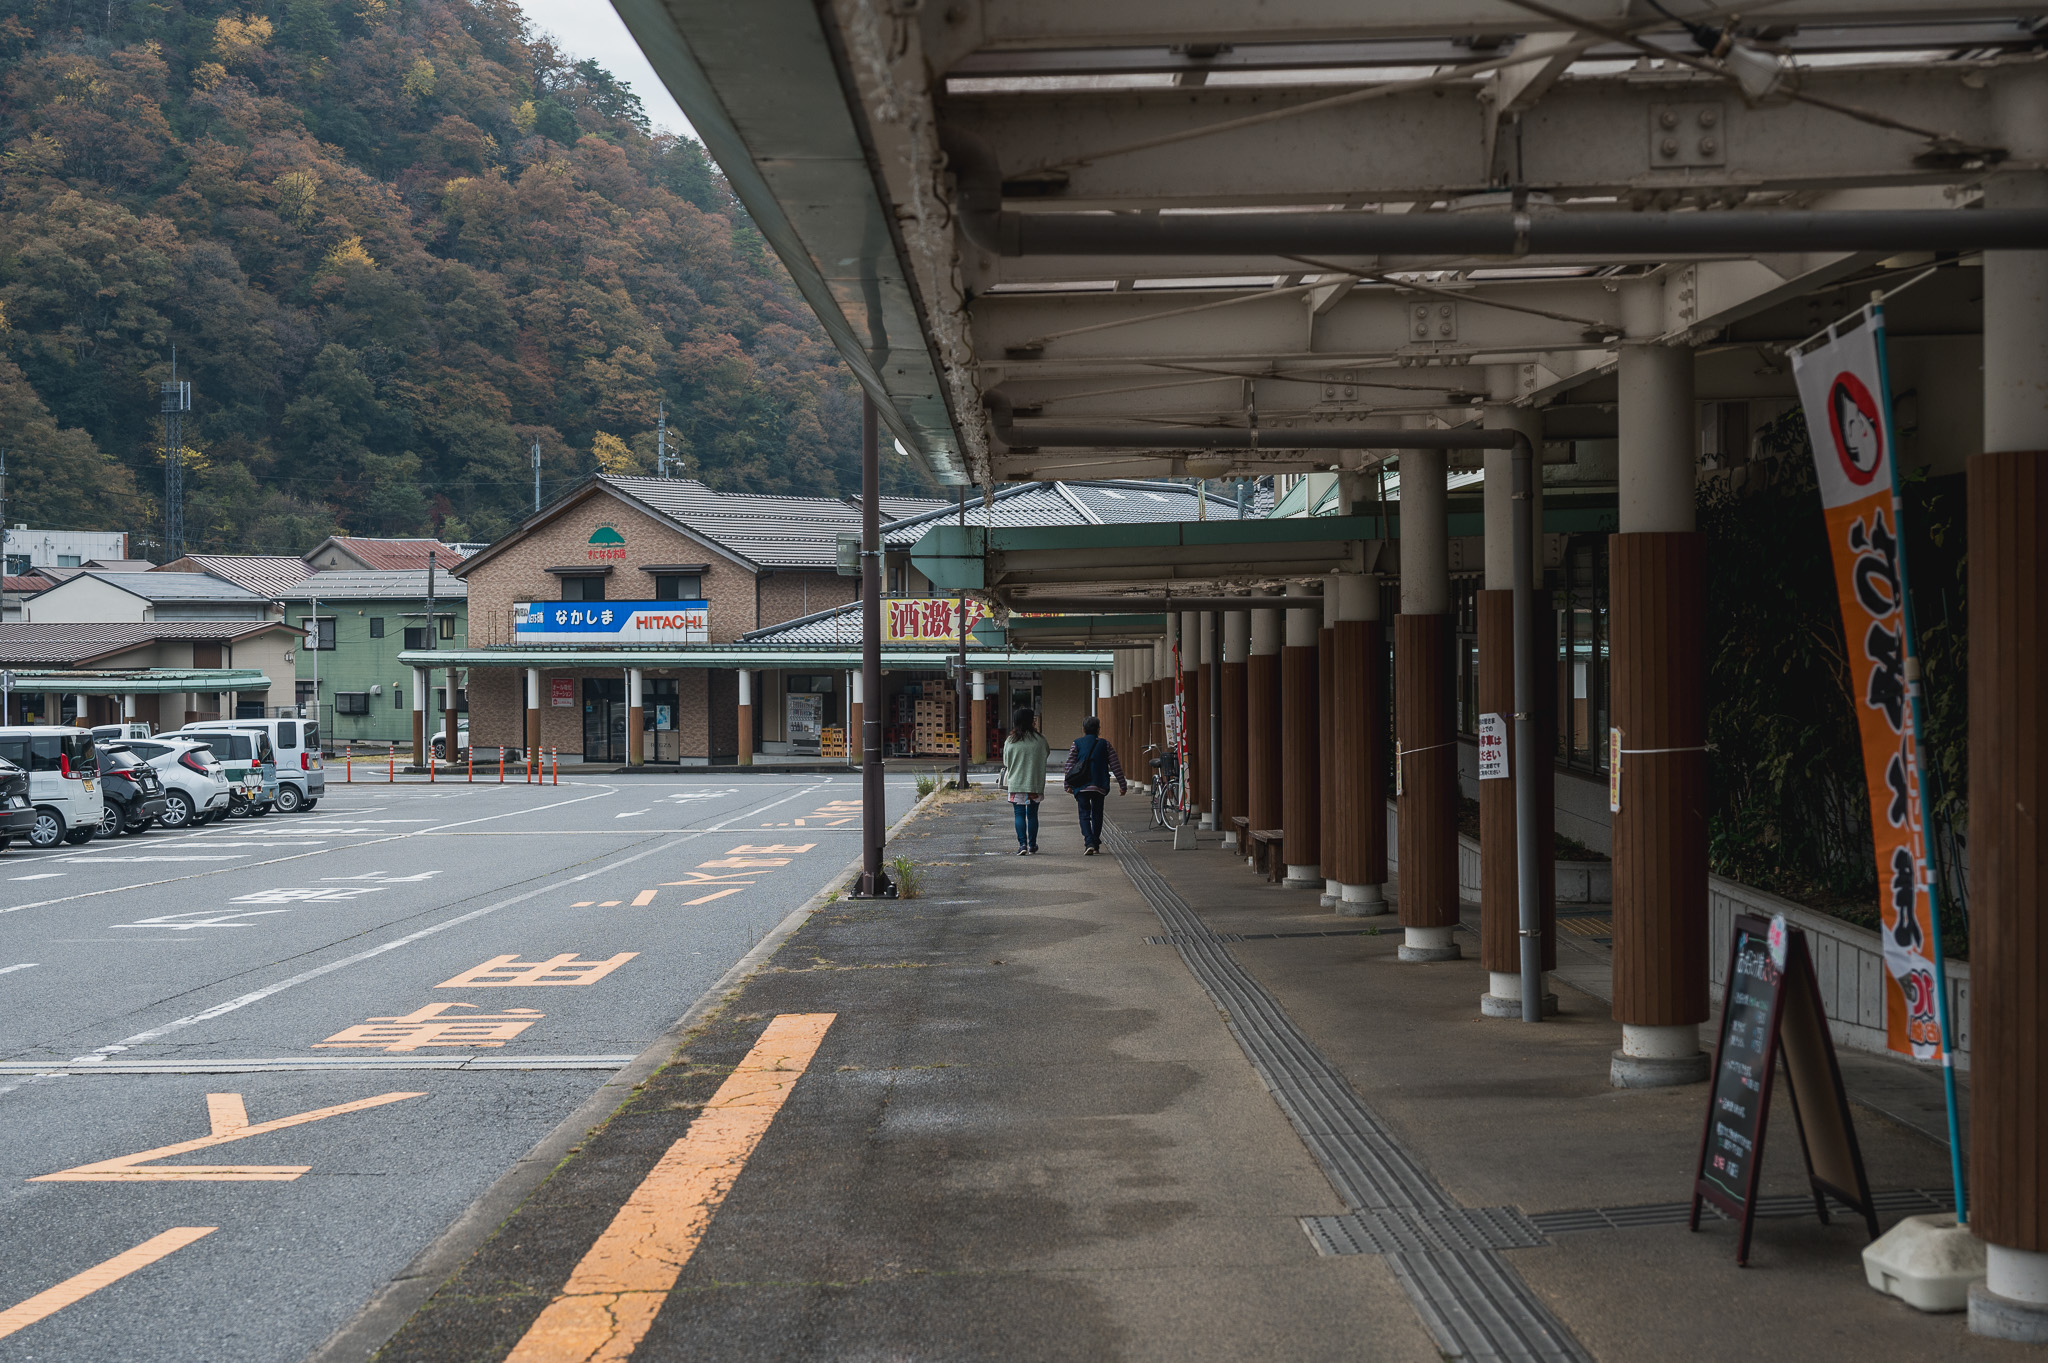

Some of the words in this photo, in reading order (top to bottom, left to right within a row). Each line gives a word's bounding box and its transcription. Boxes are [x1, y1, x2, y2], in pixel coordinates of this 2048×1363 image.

[588, 549, 626, 560] きになるお店
[555, 609, 614, 625] なかしま
[636, 615, 702, 629] HITACHI
[1479, 735, 1502, 747] 停車は
[569, 843, 818, 909] バス専用
